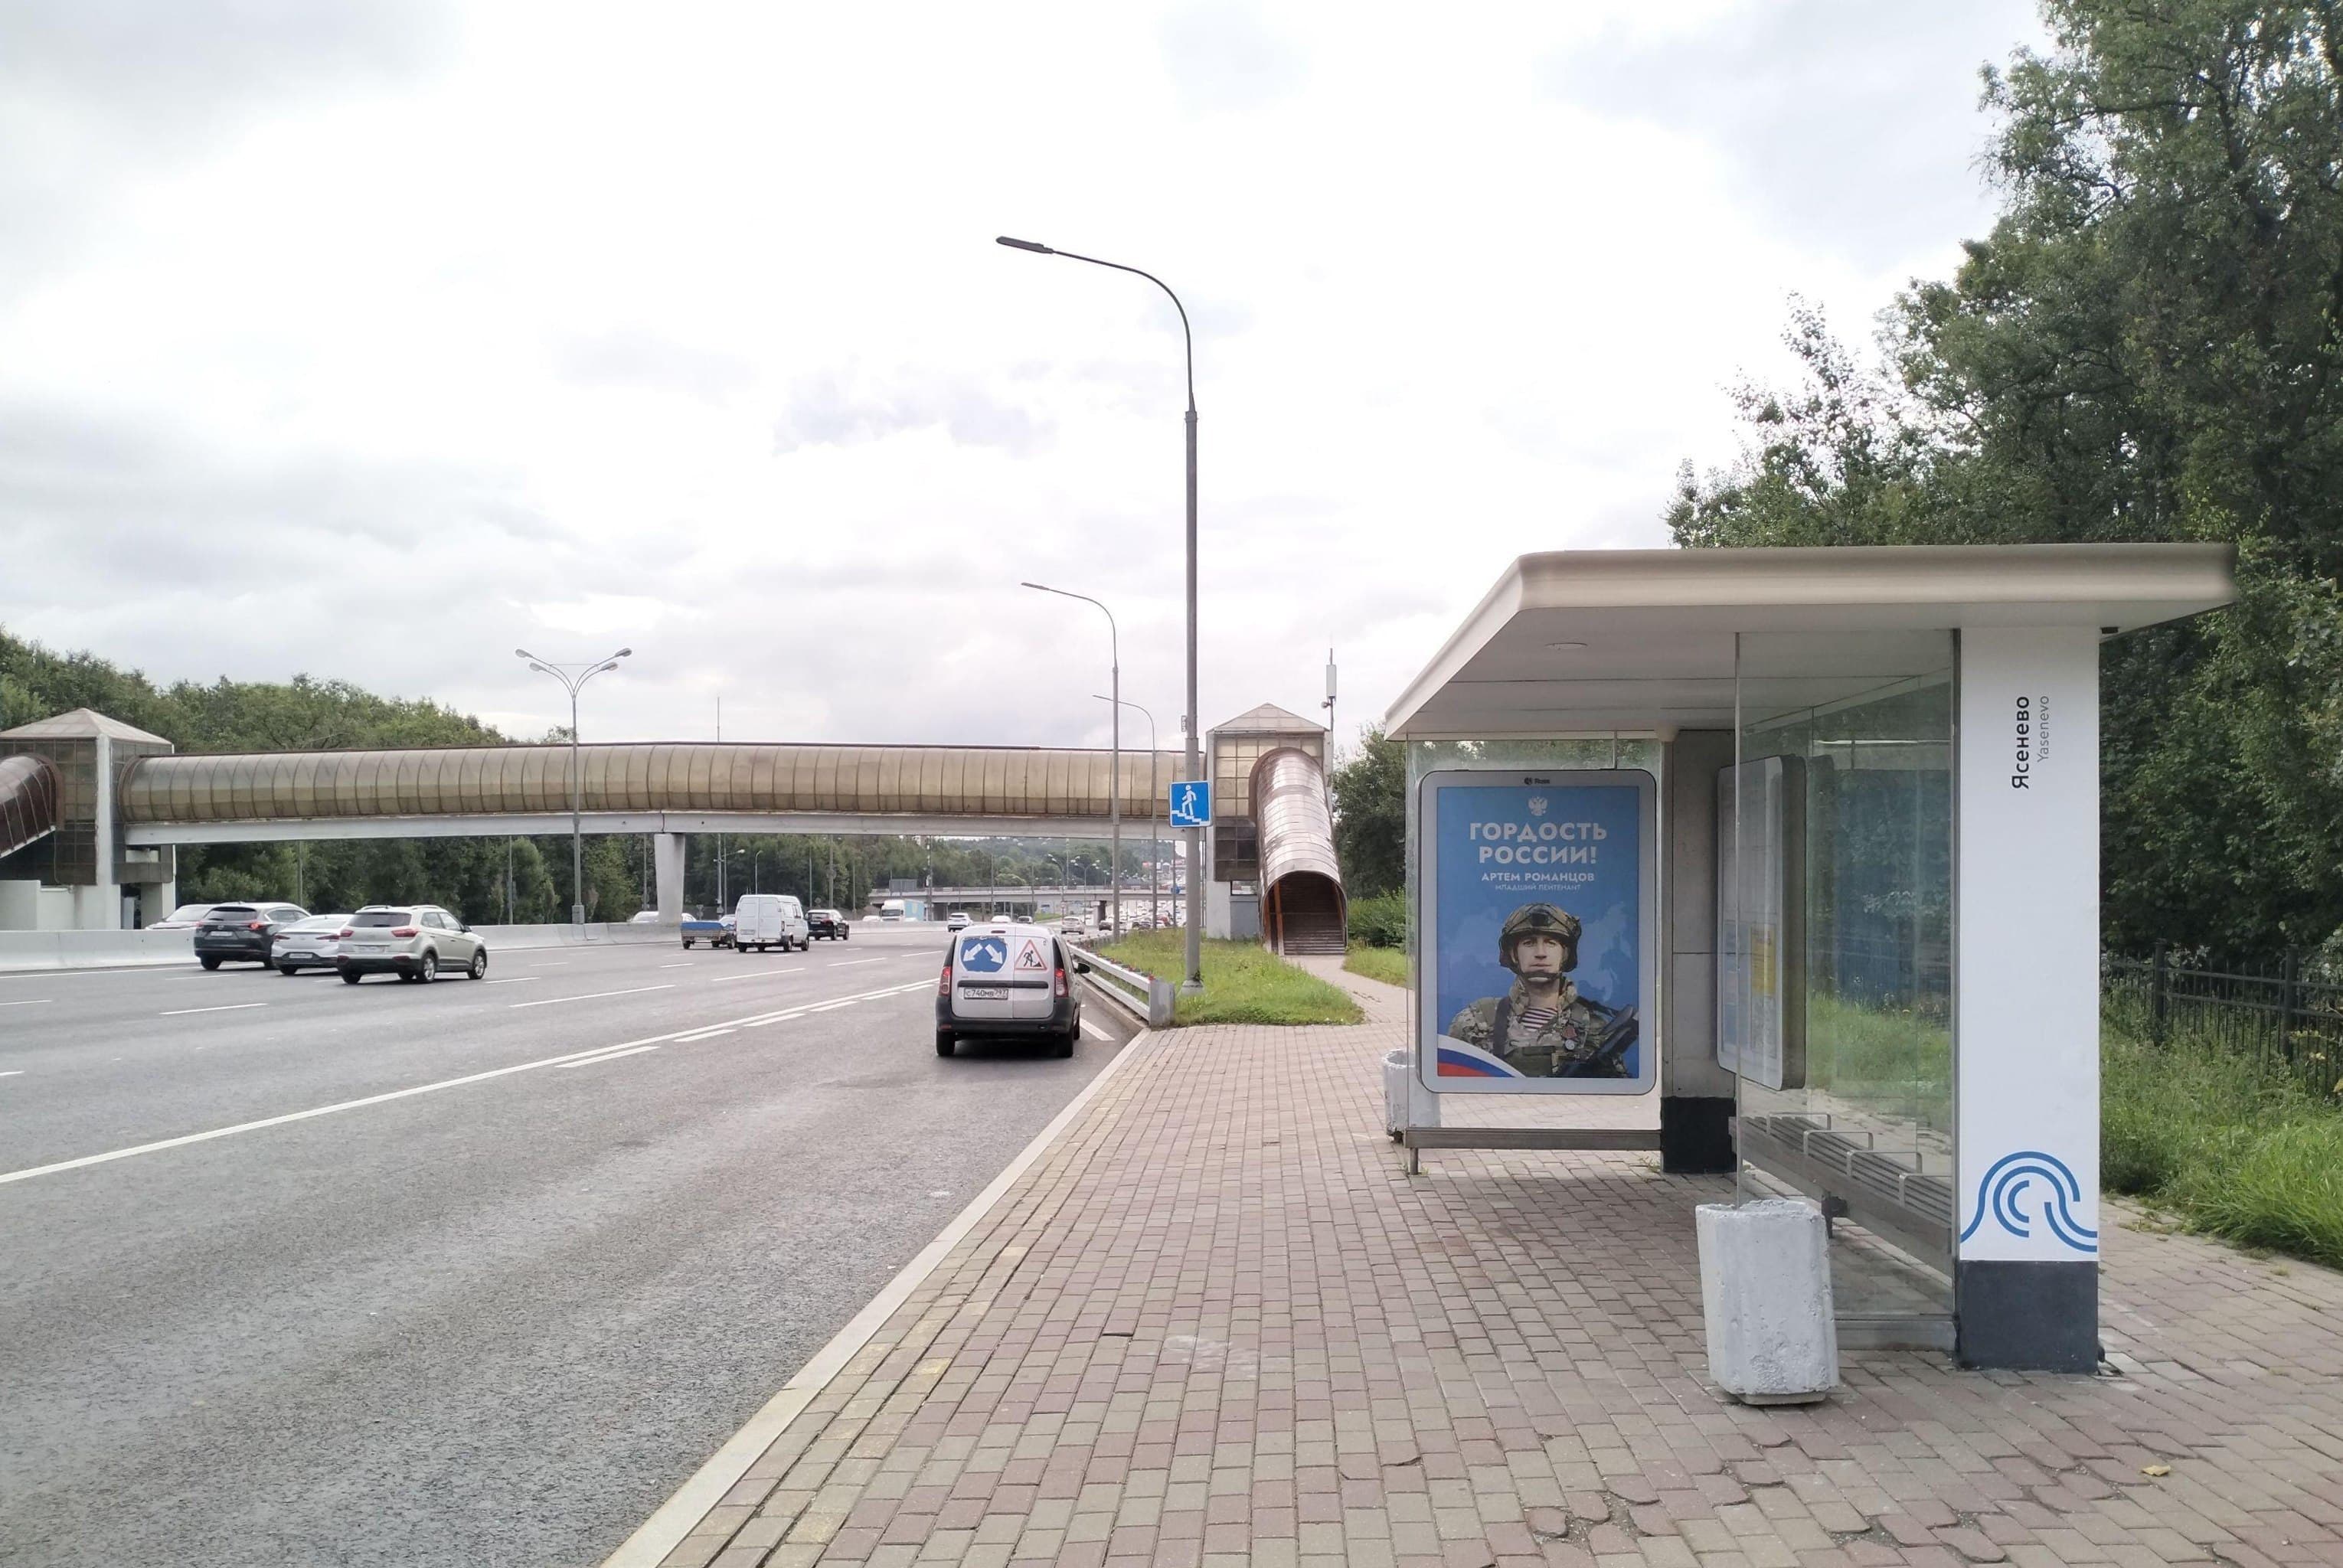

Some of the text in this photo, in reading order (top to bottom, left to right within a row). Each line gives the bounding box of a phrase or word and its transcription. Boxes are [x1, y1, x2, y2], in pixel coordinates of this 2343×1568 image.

[2037, 695, 2049, 763] Yasenevo
[2011, 696, 2029, 789] Ясенево
[1469, 822, 1607, 842] ГОРДОСТЬ
[1479, 846, 1596, 864] РОССИИ!
[1482, 872, 1595, 883] АРТЕМ РОМАНЦОВ
